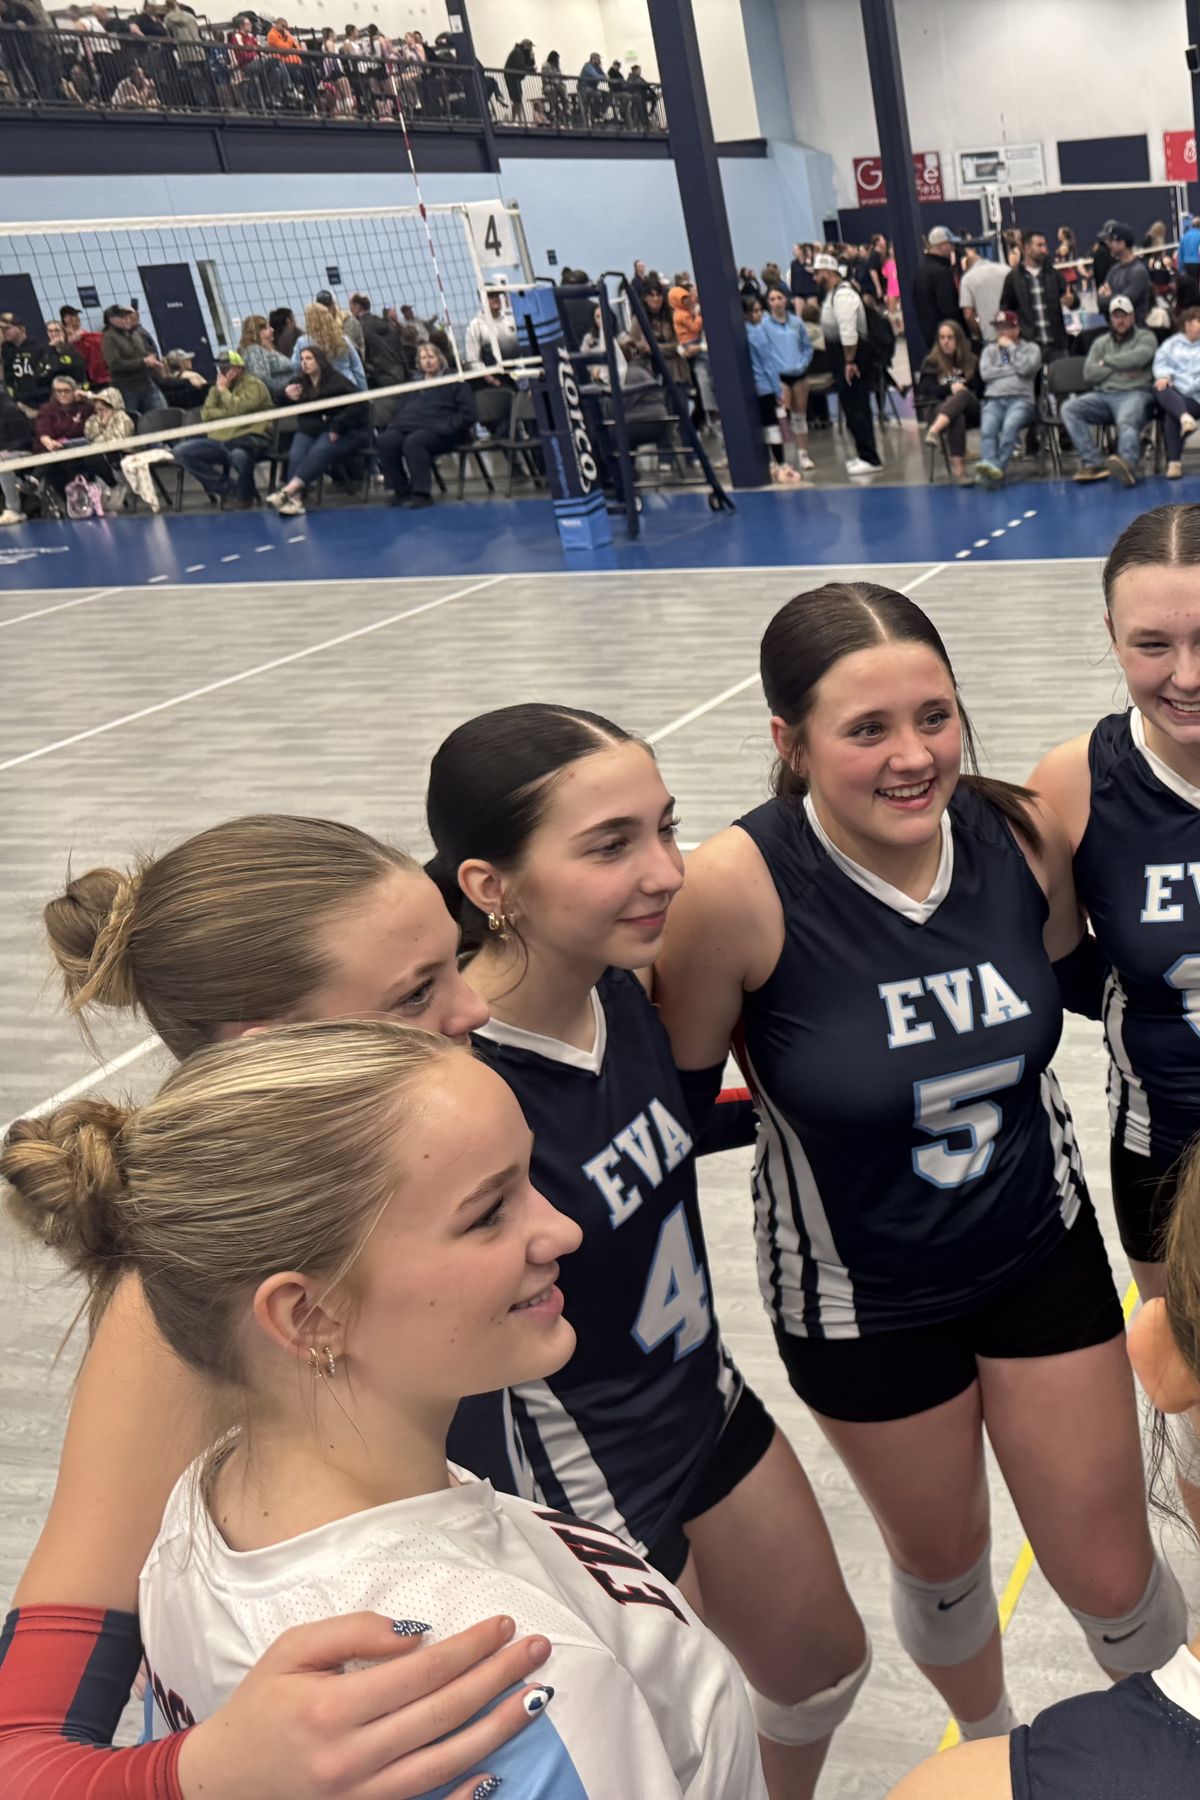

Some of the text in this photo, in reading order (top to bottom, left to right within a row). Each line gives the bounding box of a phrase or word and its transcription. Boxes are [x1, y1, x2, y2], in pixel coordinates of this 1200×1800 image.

[485, 214, 502, 256] 4
[878, 961, 1032, 1050] EVA
[582, 1097, 694, 1231] EVA
[911, 1054, 1026, 1189] 5
[630, 1200, 712, 1363] 4
